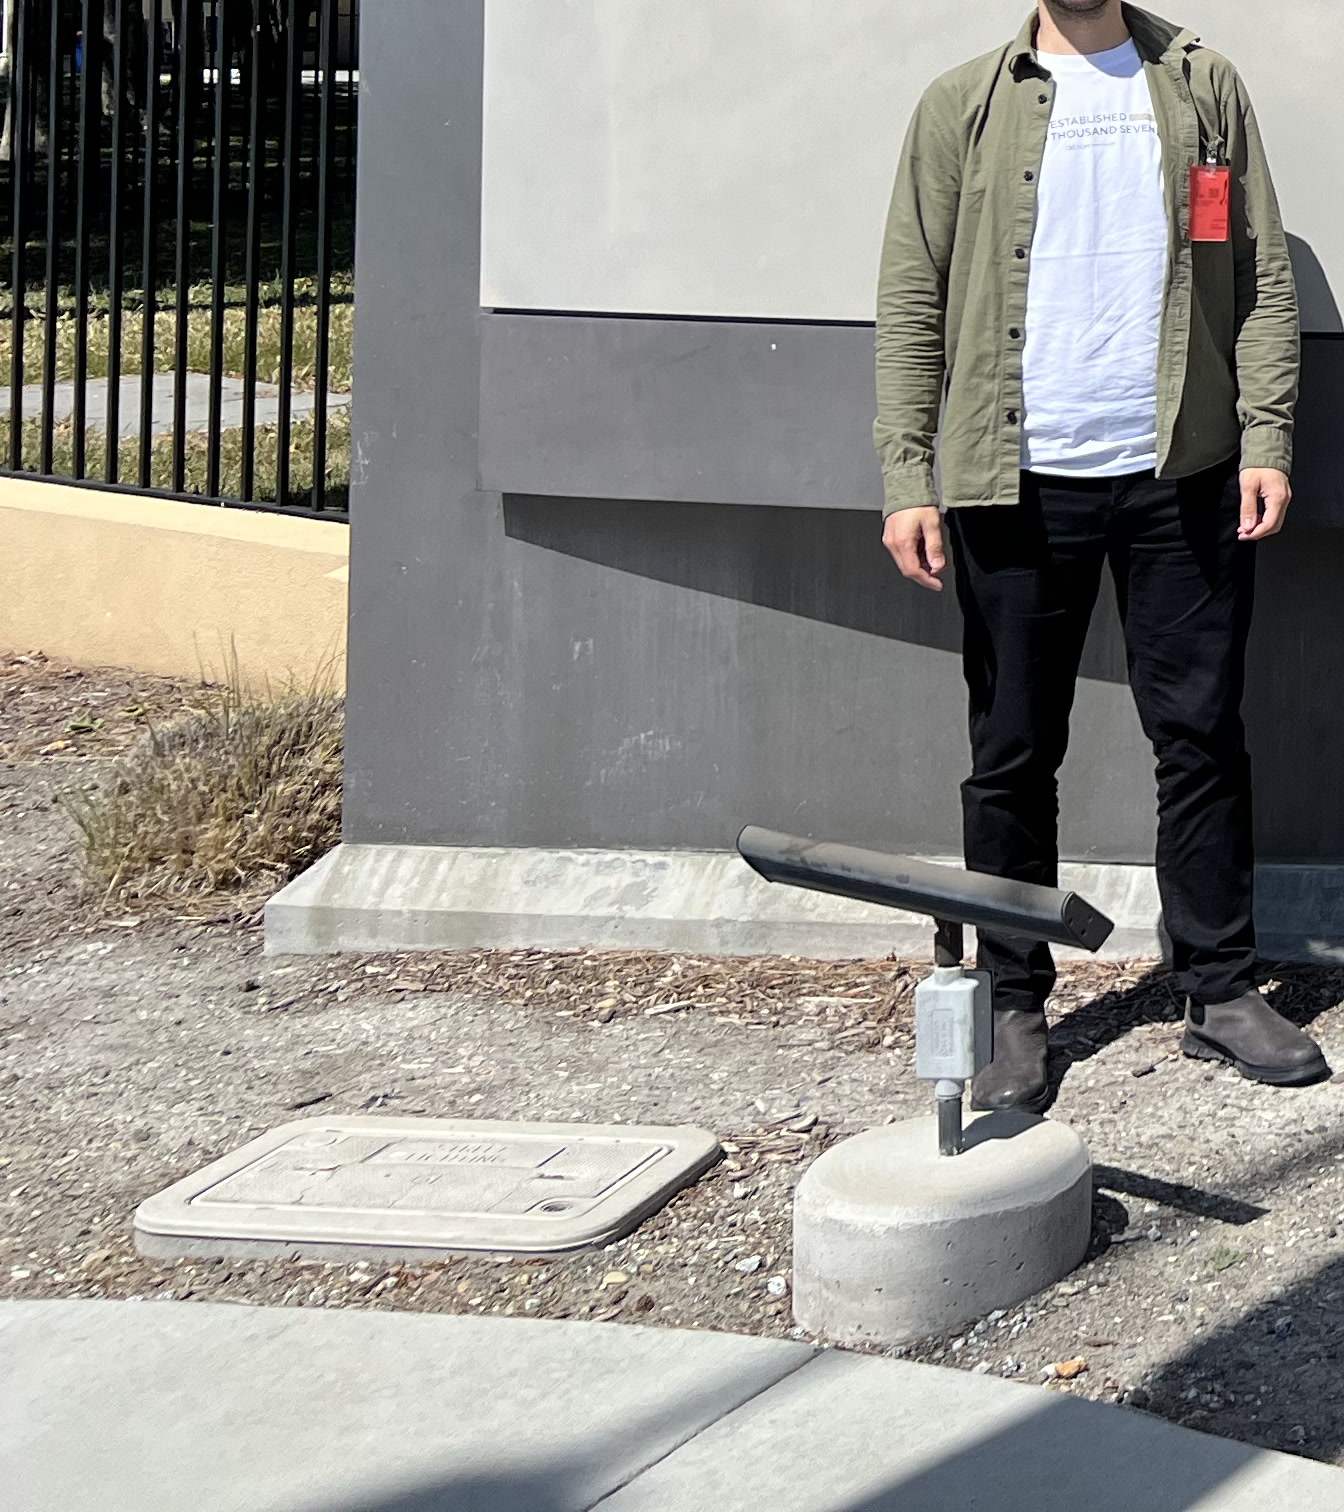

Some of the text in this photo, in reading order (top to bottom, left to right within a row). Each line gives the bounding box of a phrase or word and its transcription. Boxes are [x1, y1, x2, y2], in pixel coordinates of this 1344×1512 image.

[1050, 113, 1126, 128] ESTABLISHED
[1051, 124, 1155, 141] THOUSAND SEVEN
